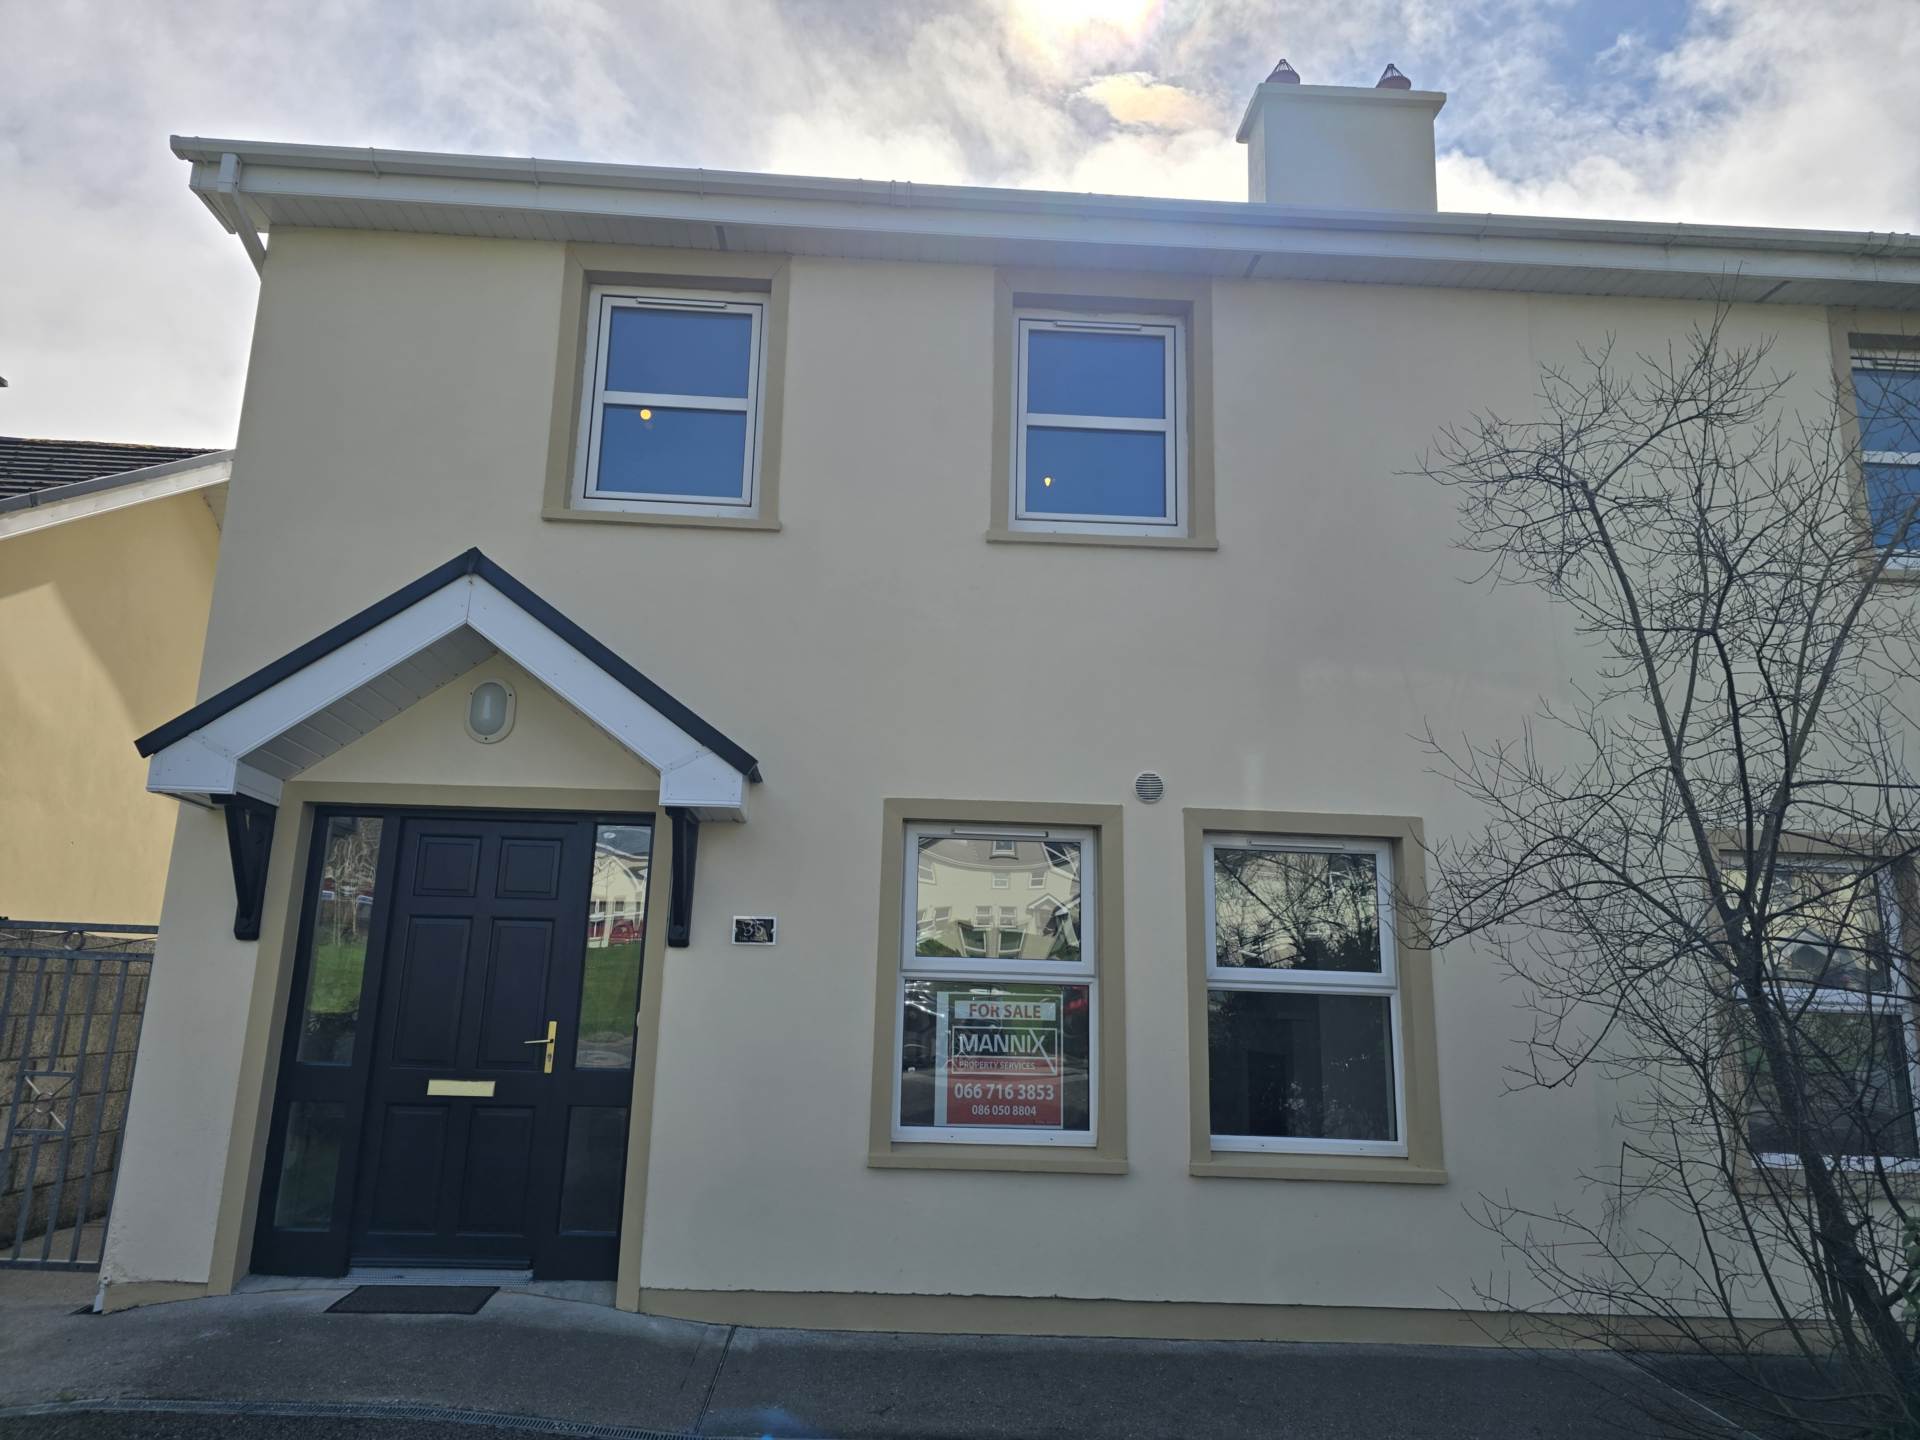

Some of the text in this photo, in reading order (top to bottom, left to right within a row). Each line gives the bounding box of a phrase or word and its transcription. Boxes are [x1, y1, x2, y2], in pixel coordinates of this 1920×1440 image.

[969, 1004, 1041, 1018] FOR SALE
[959, 1030, 1048, 1056] MANNIX
[959, 1060, 1036, 1070] PROPERTY SERVICES
[954, 1083, 1054, 1101] 066 716 3853
[972, 1105, 1036, 1116] 086 050 8804
